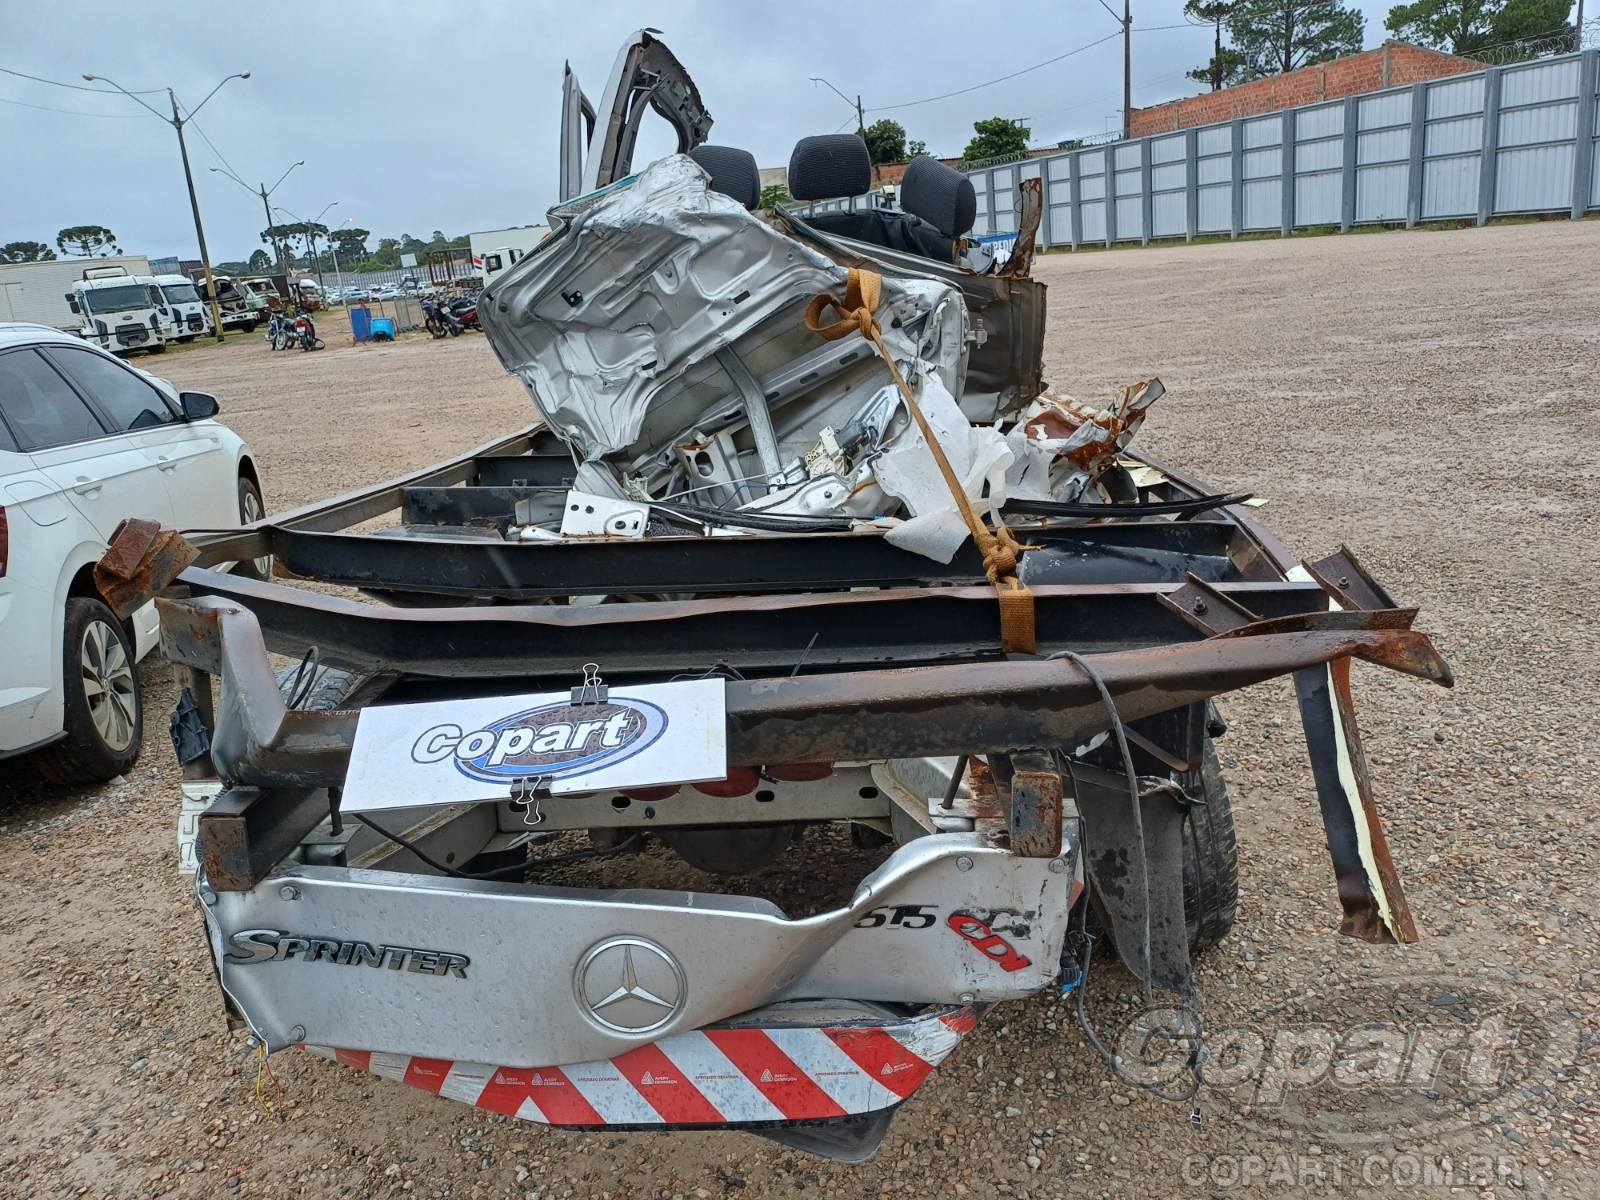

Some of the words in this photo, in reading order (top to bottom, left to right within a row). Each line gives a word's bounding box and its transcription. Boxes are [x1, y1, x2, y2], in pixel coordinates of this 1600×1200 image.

[411, 707, 636, 769] Copart
[853, 904, 939, 929] 515
[225, 928, 471, 979] SPRINTER
